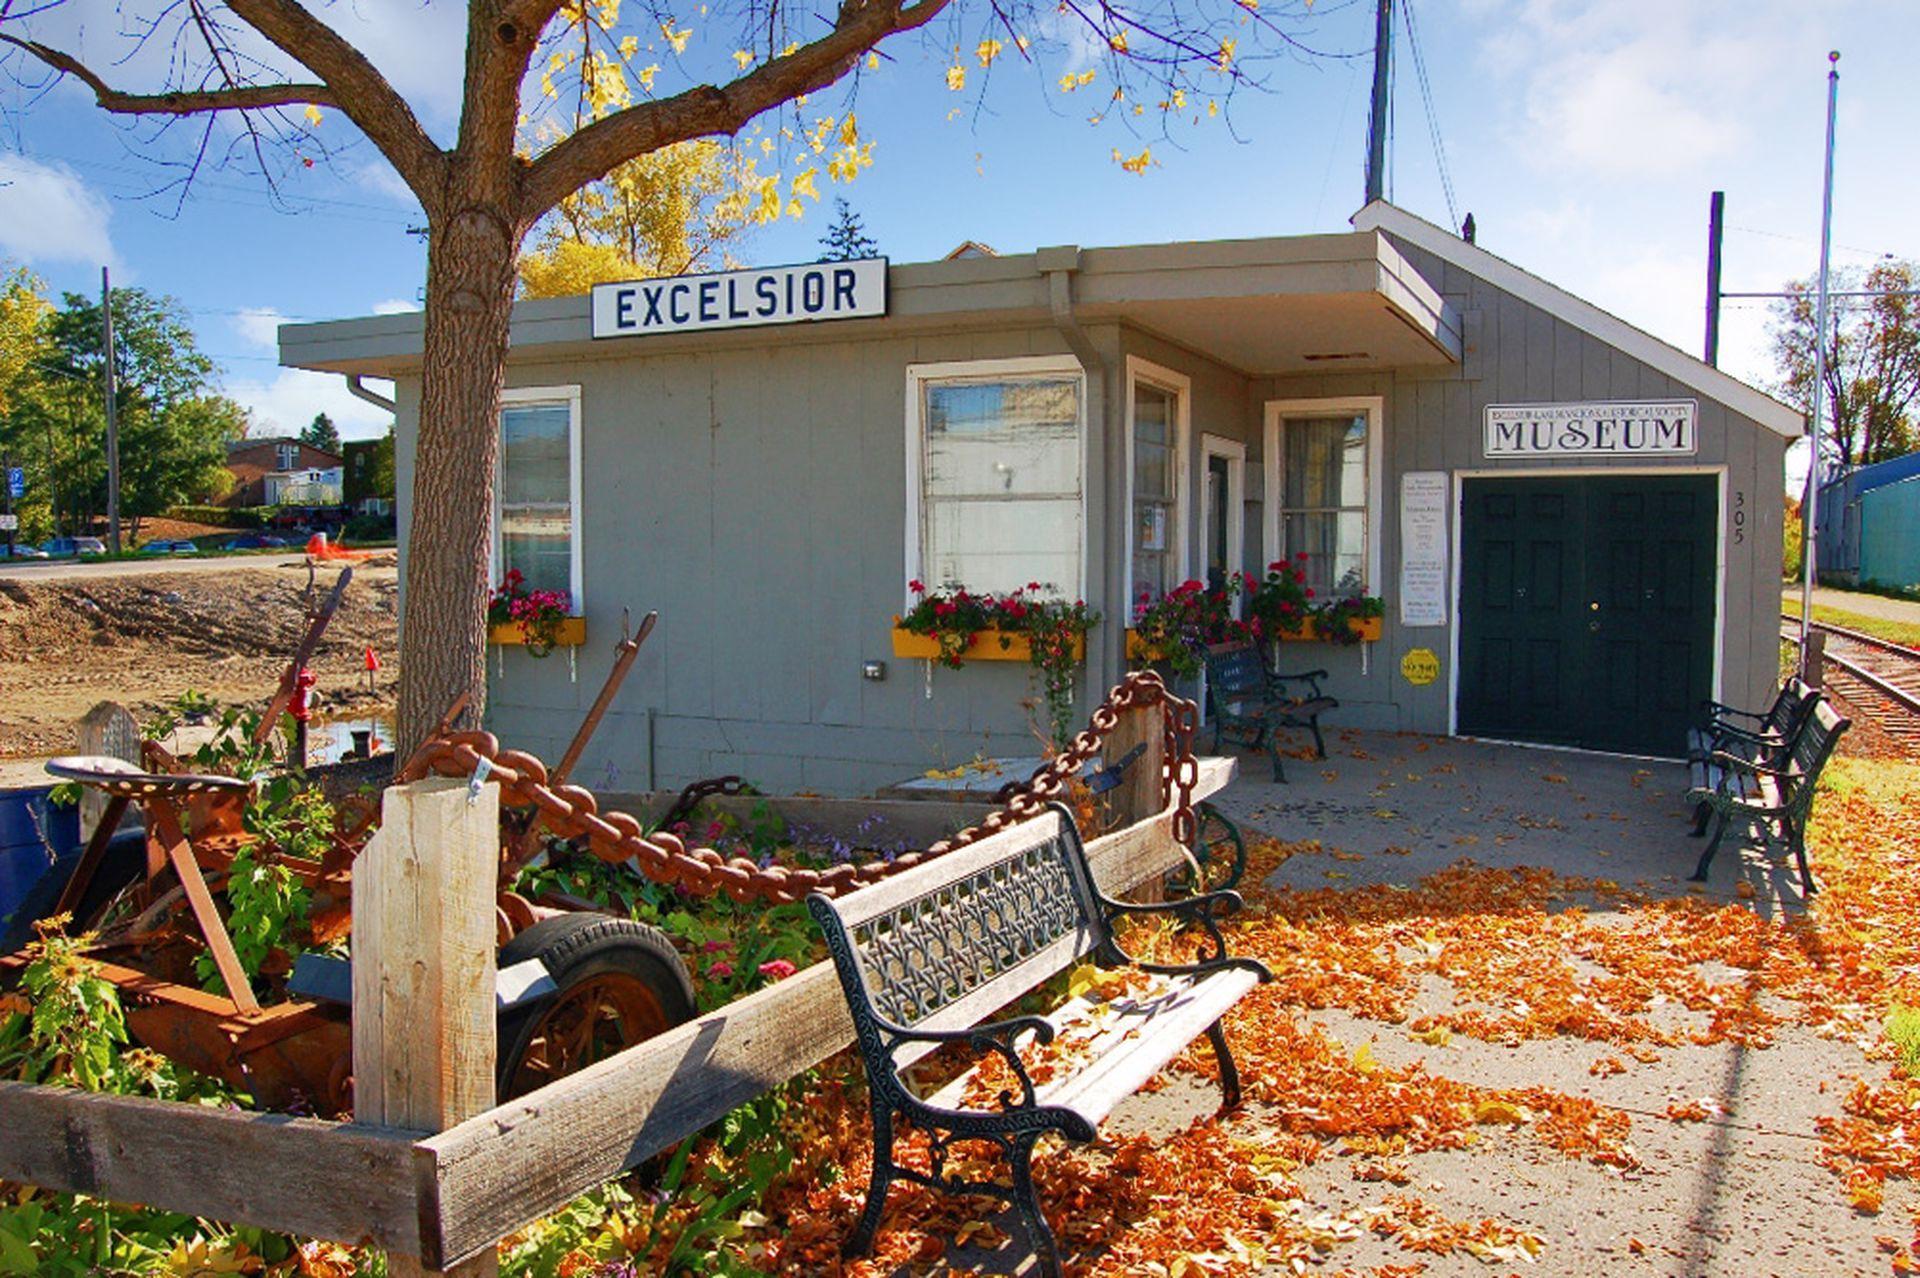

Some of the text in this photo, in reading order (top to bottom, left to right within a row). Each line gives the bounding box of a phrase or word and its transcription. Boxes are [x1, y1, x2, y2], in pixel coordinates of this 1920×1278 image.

[616, 268, 857, 329] EXCELSIOR
[1493, 417, 1687, 451] MUSEUM
[1734, 491, 1745, 545] 305
